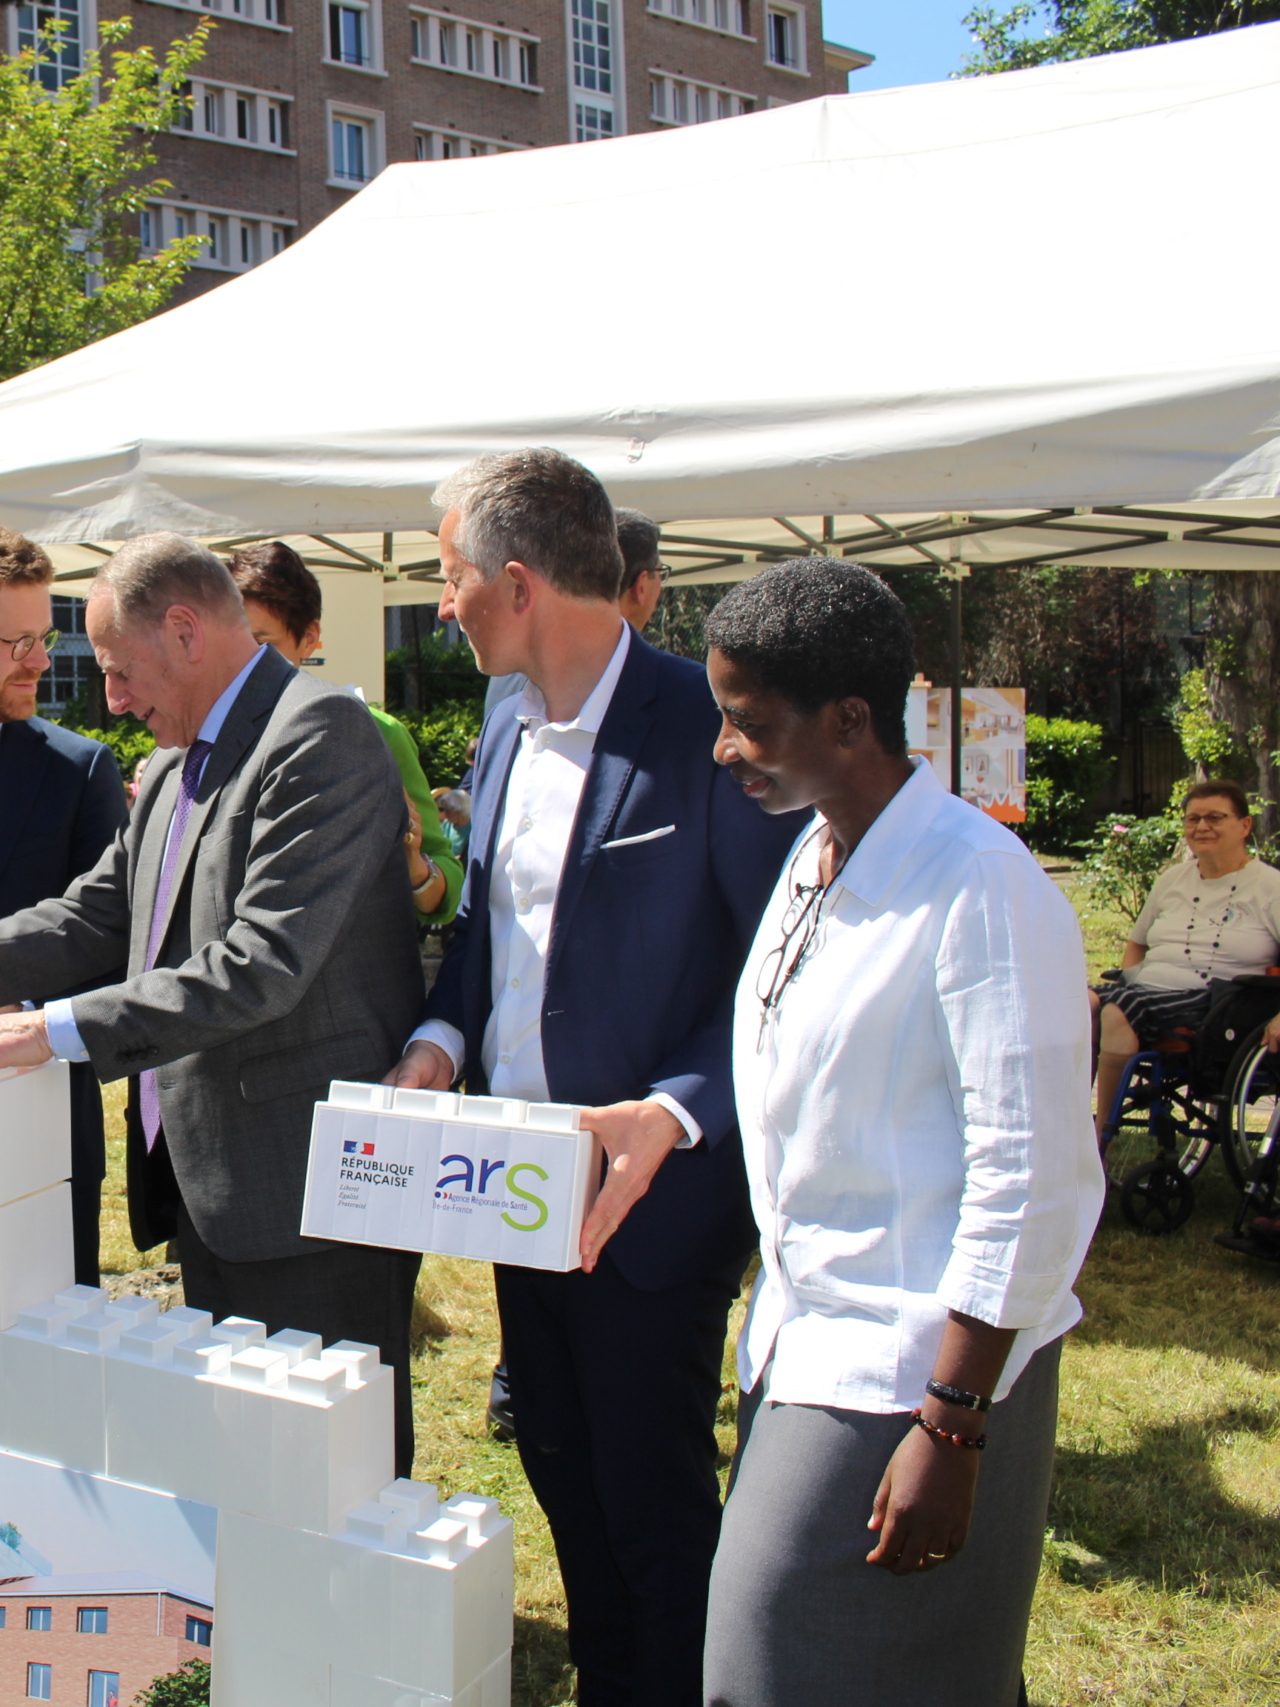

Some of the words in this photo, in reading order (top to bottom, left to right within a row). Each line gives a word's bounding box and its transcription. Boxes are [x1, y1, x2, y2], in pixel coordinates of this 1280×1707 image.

[341, 1156, 415, 1176] RÉPUBLIQUE
[340, 1169, 408, 1188] FRANÇAISE
[448, 1193, 470, 1203] Agence
[471, 1196, 500, 1208] Régionale
[501, 1201, 509, 1209] de
[510, 1201, 528, 1211] Santé
